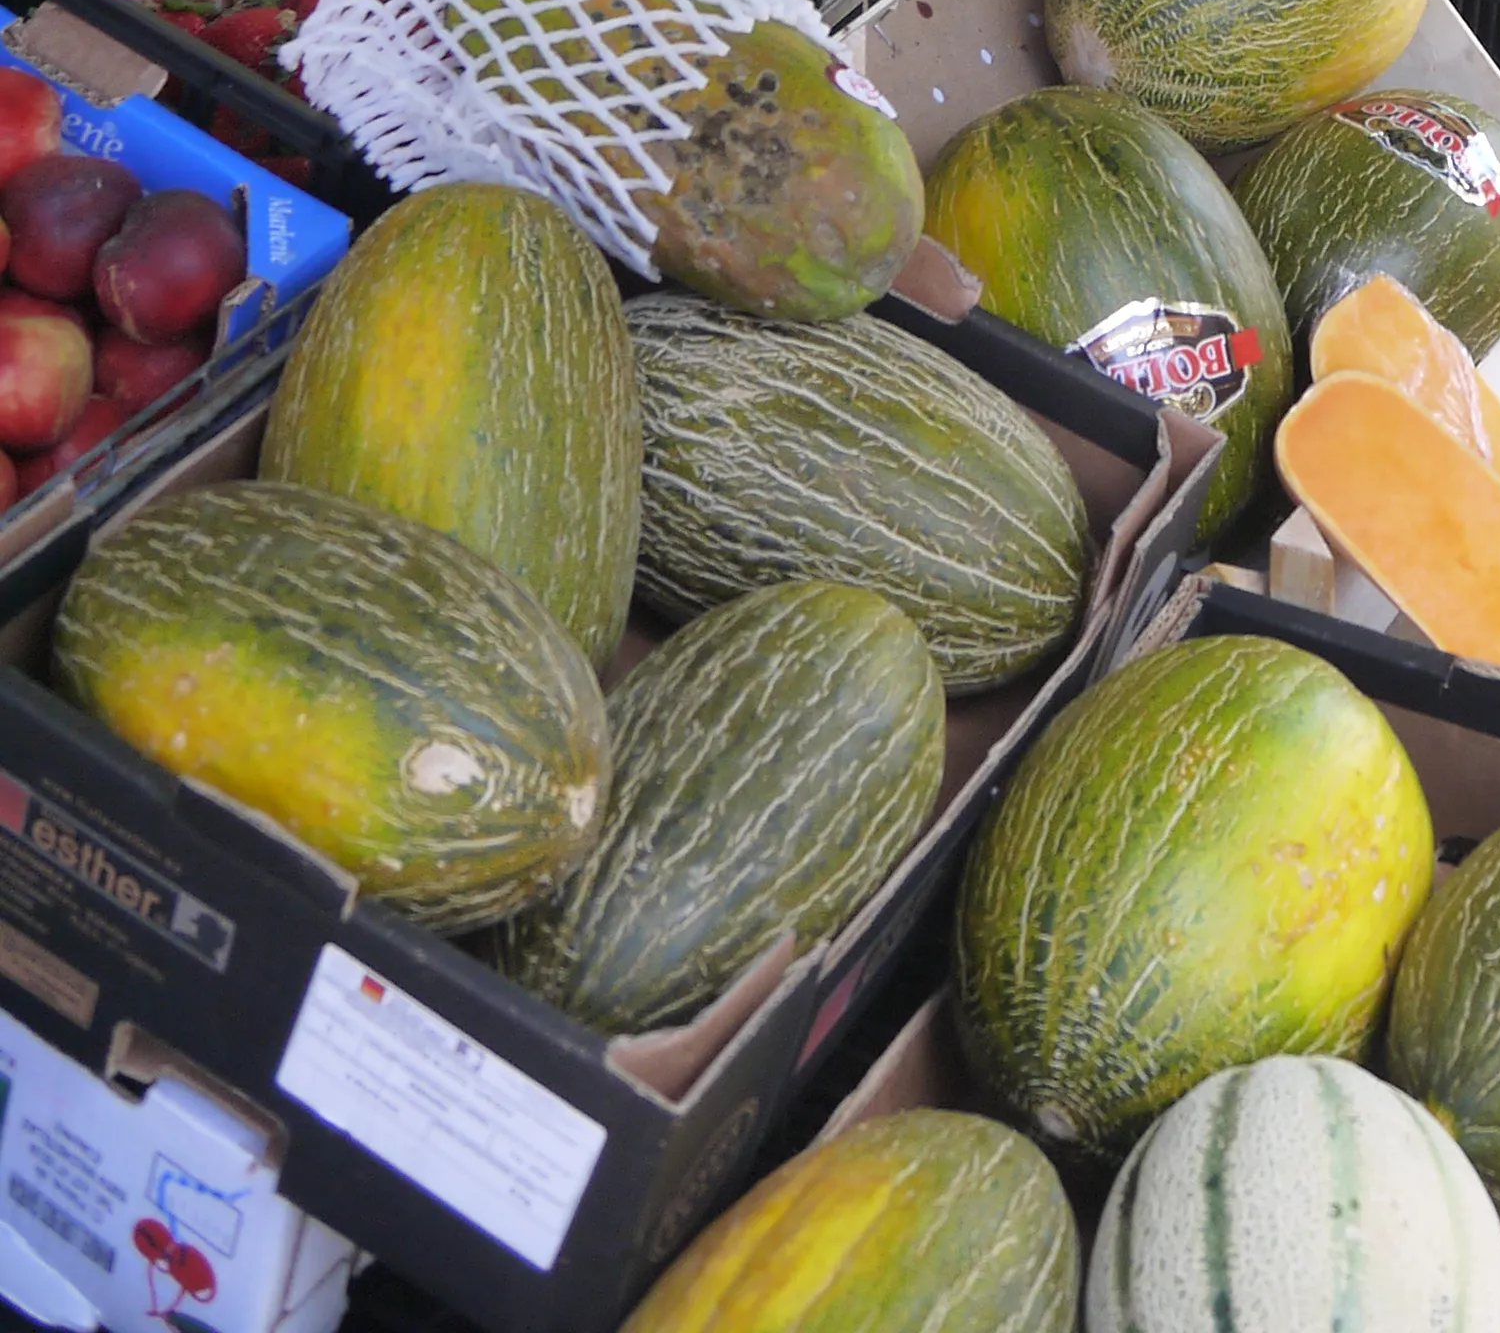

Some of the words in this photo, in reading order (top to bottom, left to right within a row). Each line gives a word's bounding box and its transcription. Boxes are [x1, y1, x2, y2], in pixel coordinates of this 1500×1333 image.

[1361, 100, 1465, 154] OLLO
[267, 195, 298, 266] Marlene
[1107, 333, 1232, 398] BOLL
[31, 817, 162, 921] esther
